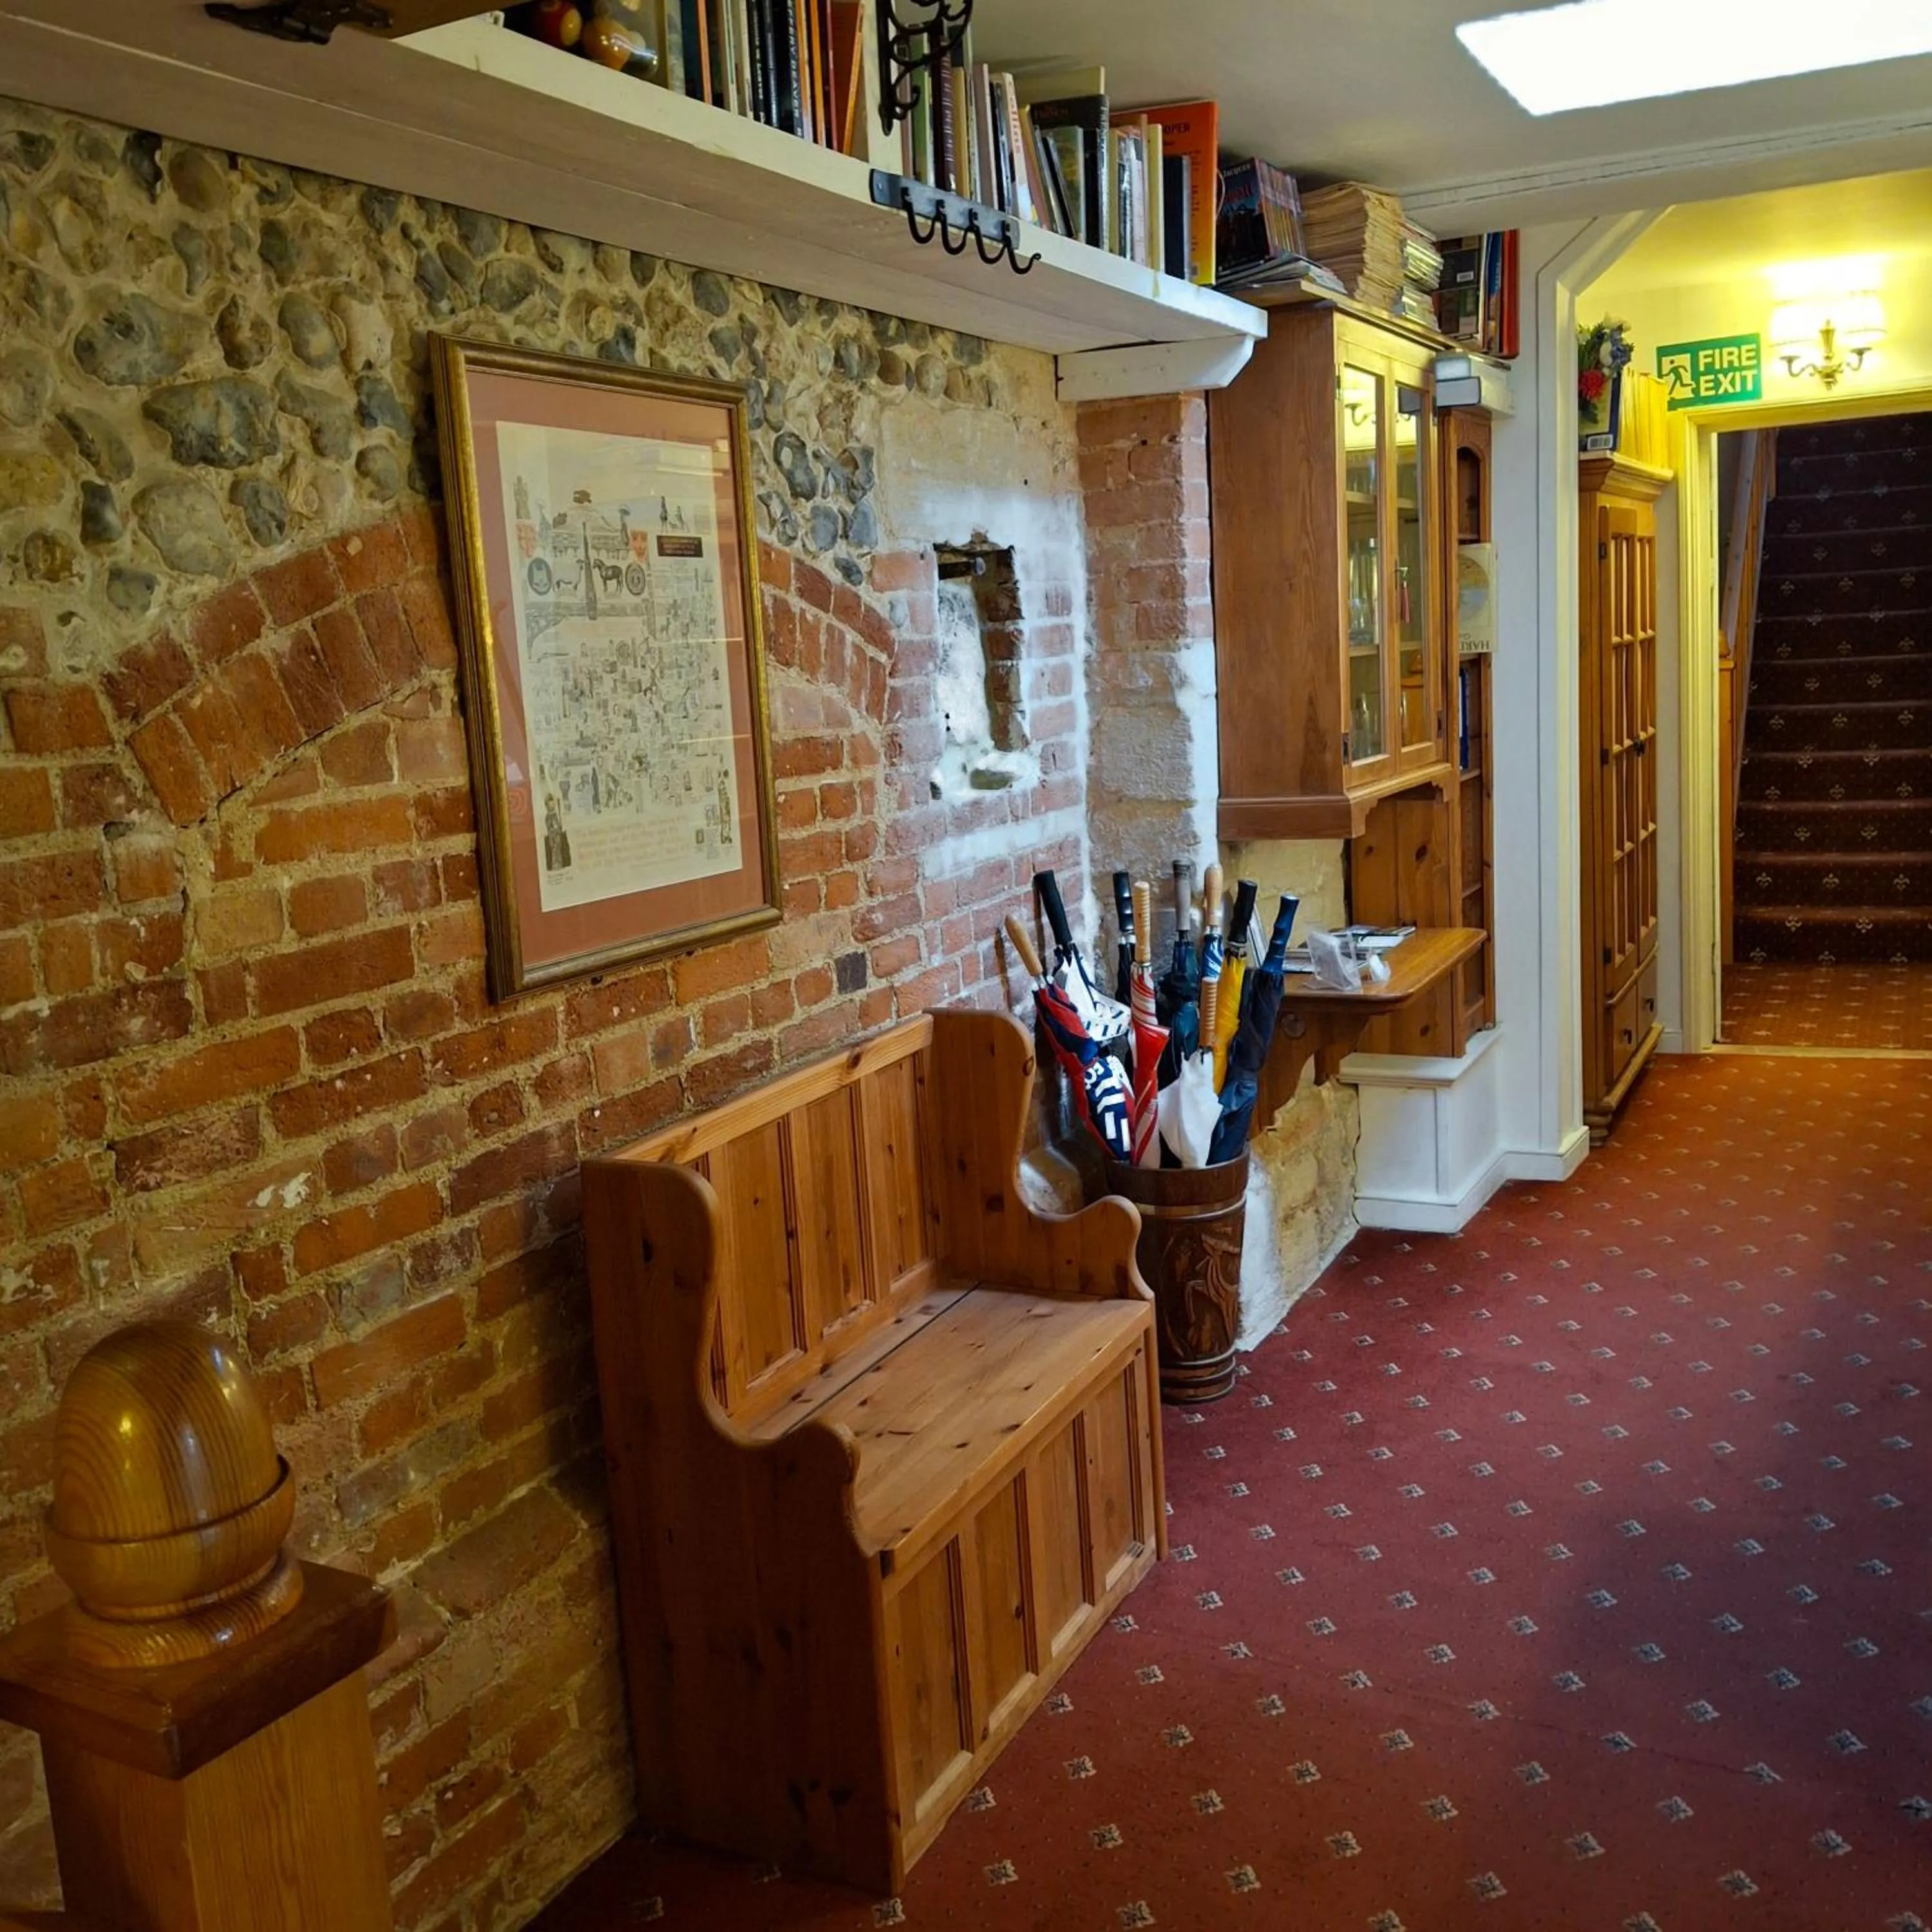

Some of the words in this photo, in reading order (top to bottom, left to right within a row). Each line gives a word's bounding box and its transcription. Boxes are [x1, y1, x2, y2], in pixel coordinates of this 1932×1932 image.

[791, 60, 800, 118] DEAVER
[1162, 122, 1190, 133] OPER
[1698, 344, 1757, 371] FIRE
[1700, 370, 1757, 397] EXIT
